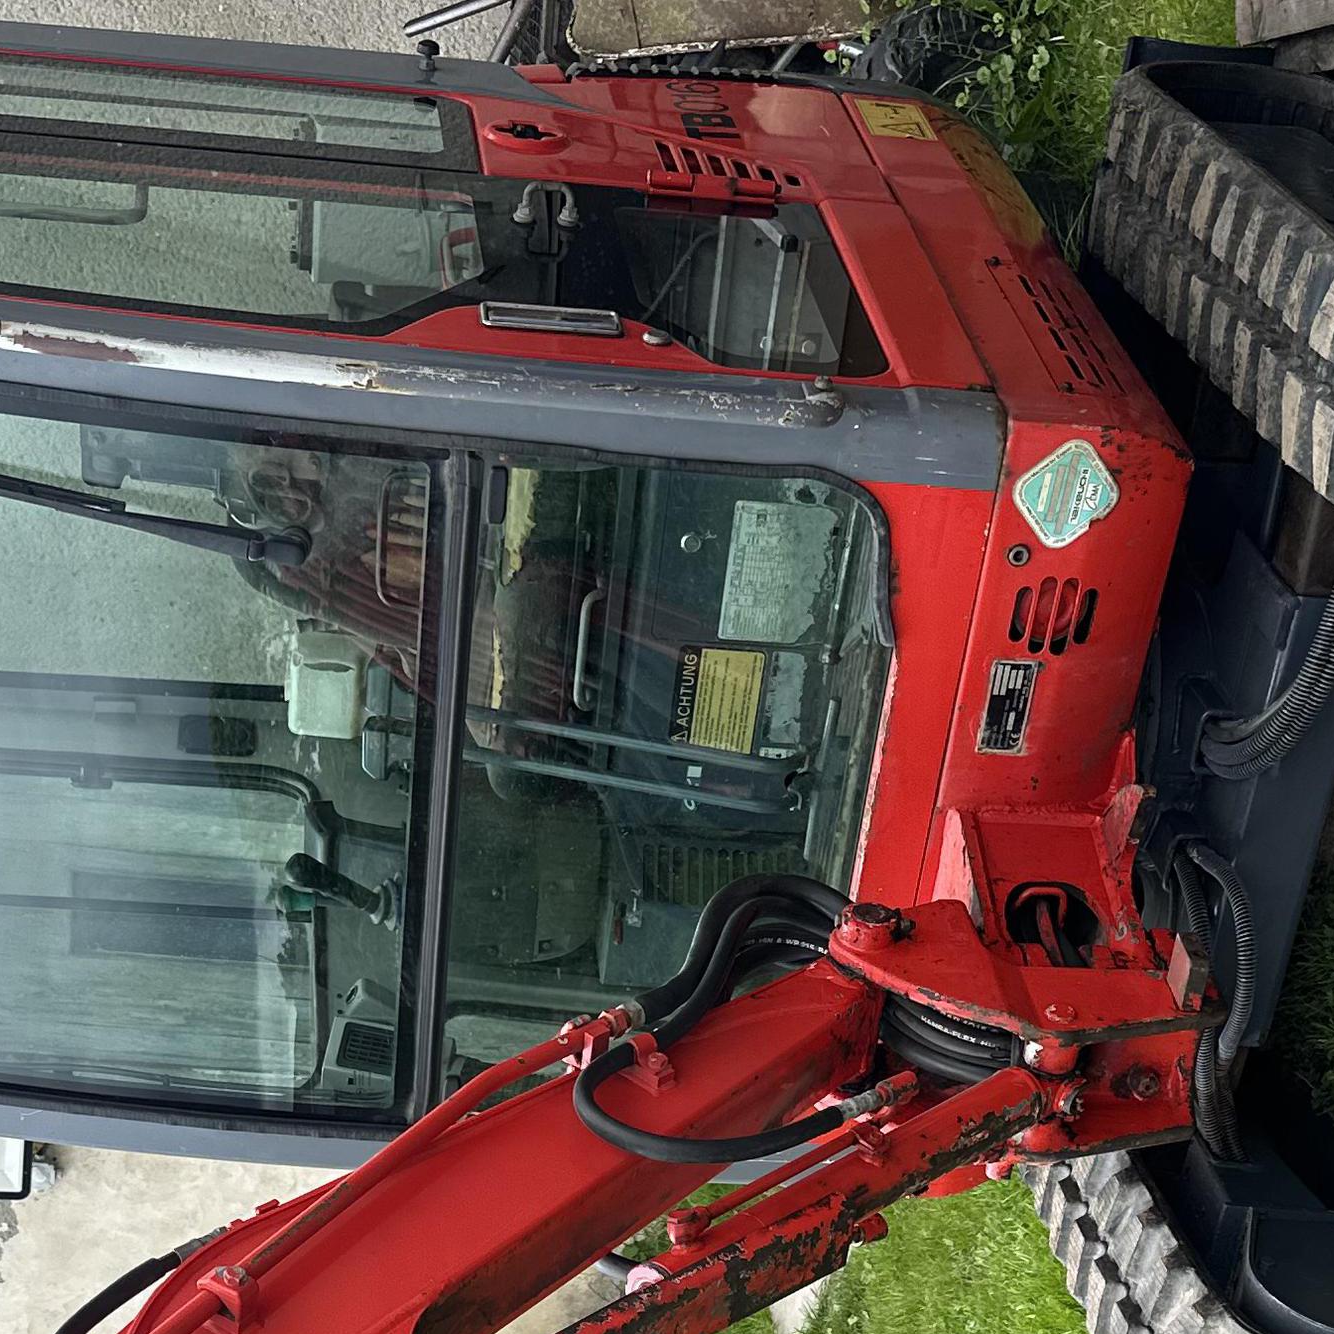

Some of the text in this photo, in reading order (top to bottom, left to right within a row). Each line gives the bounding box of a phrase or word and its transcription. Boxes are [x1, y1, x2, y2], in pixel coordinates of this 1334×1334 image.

[666, 82, 741, 140] TB016
[1070, 469, 1089, 523] TAKEUCHI
[676, 653, 698, 727] ACHTUNG
